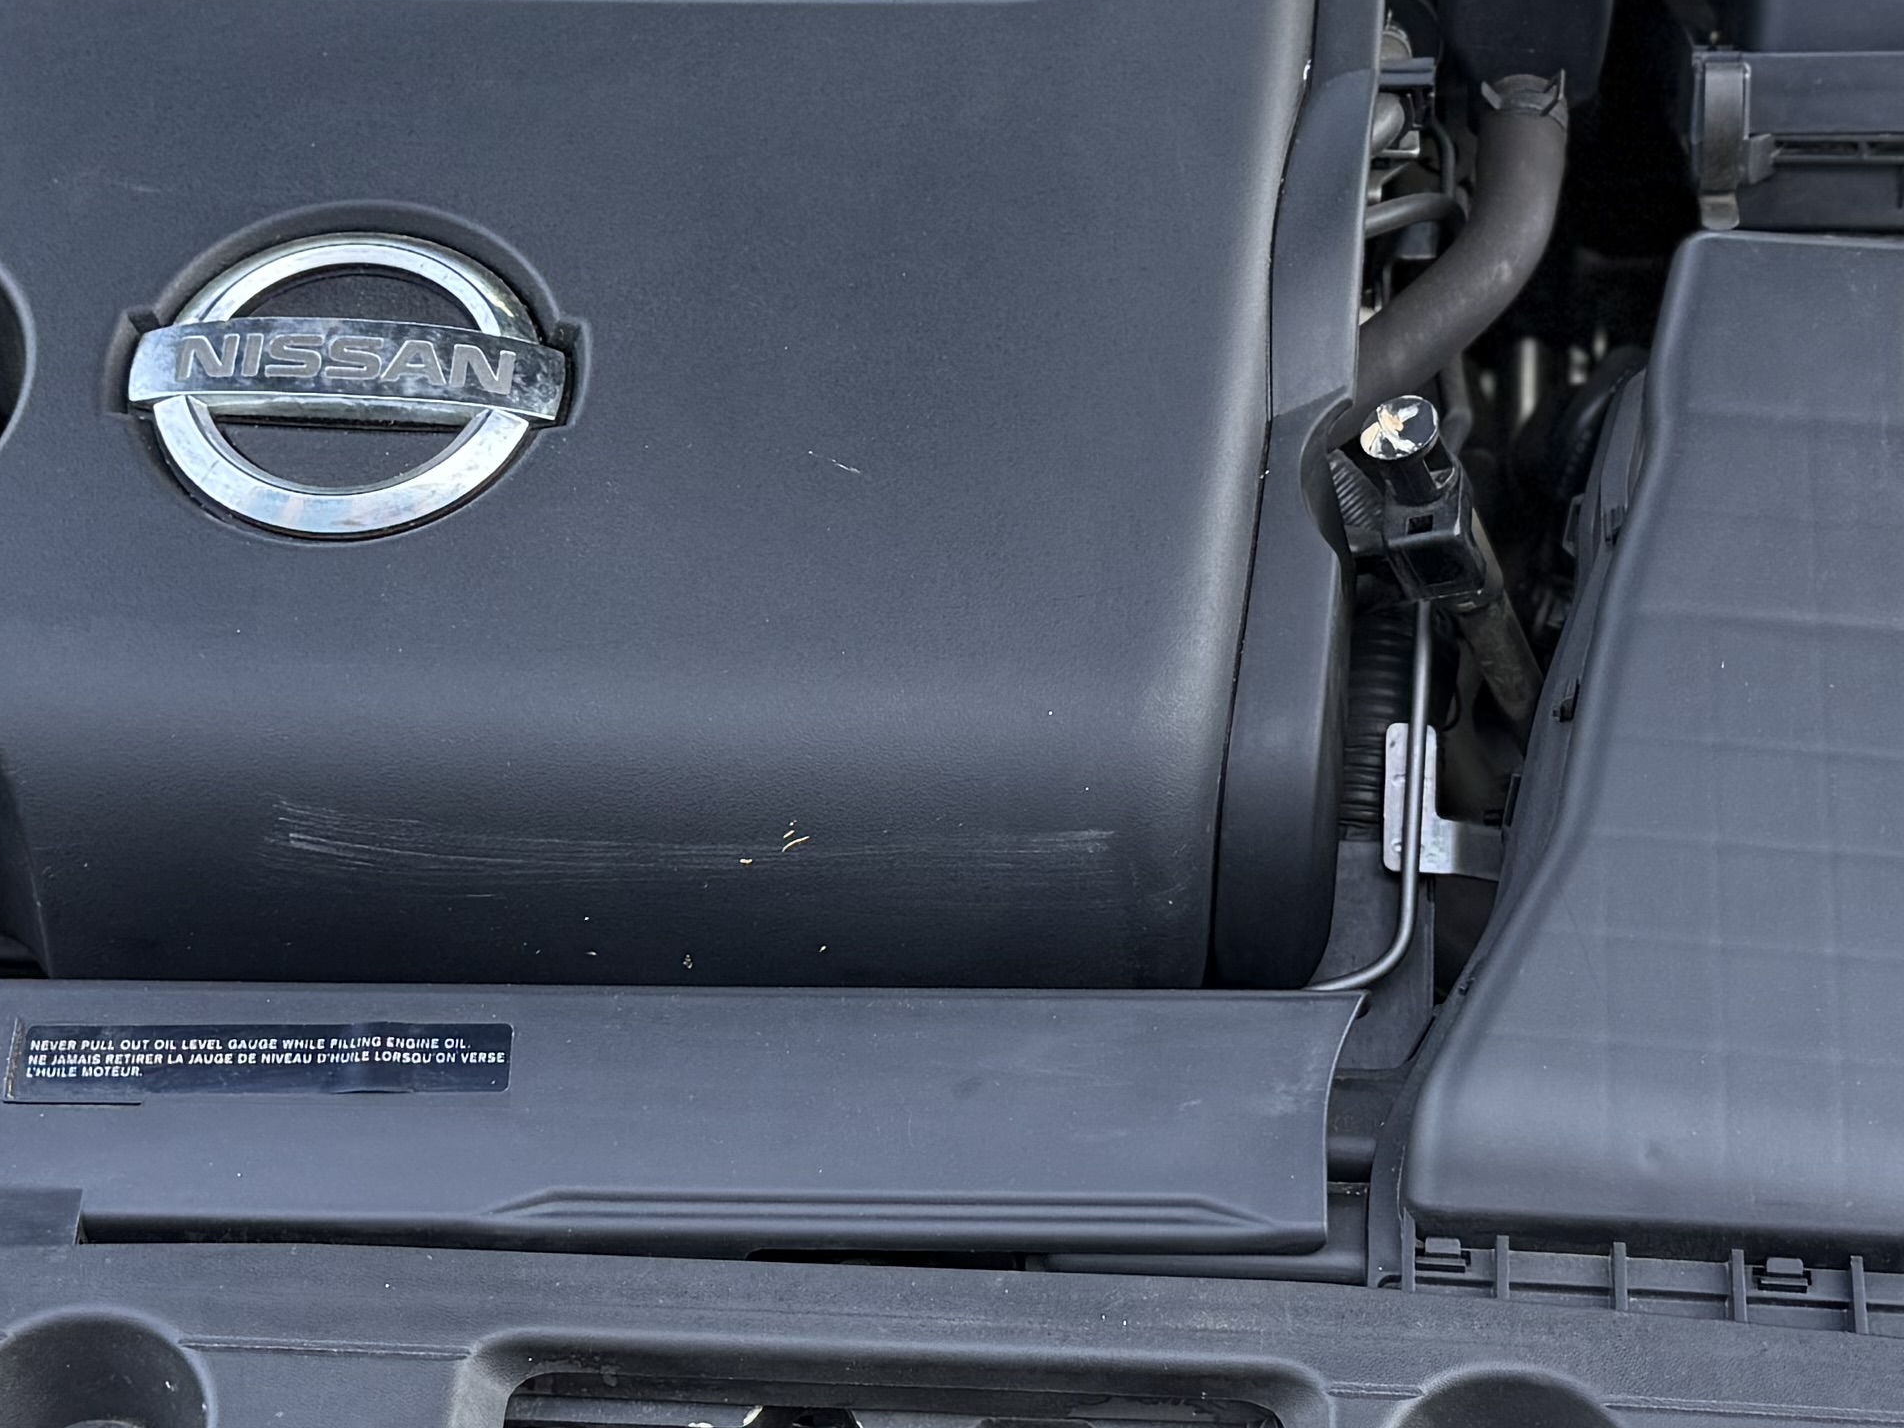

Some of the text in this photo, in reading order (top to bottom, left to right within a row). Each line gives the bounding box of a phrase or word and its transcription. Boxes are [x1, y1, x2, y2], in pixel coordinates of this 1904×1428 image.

[174, 332, 517, 396] NISSAN
[30, 1040, 76, 1051] NEVER
[80, 1040, 114, 1051] PULL
[119, 1039, 150, 1050] OUT
[154, 1039, 176, 1050] OIL
[181, 1039, 222, 1050] LEVEL
[227, 1038, 277, 1049] GAUGE
[282, 1038, 325, 1049] WHILE
[330, 1038, 381, 1049] FILLING
[386, 1038, 439, 1049] ENGINE
[28, 1054, 47, 1065] NE
[51, 1054, 100, 1065] JAMAIS
[105, 1054, 163, 1064] RETIRER
[167, 1054, 183, 1064] LA
[187, 1053, 233, 1064] JAUGE
[237, 1053, 256, 1064] DE
[261, 1053, 312, 1064] NIVEAU
[460, 1052, 505, 1063] VERSE
[81, 1067, 142, 1077] MOTEUR.
